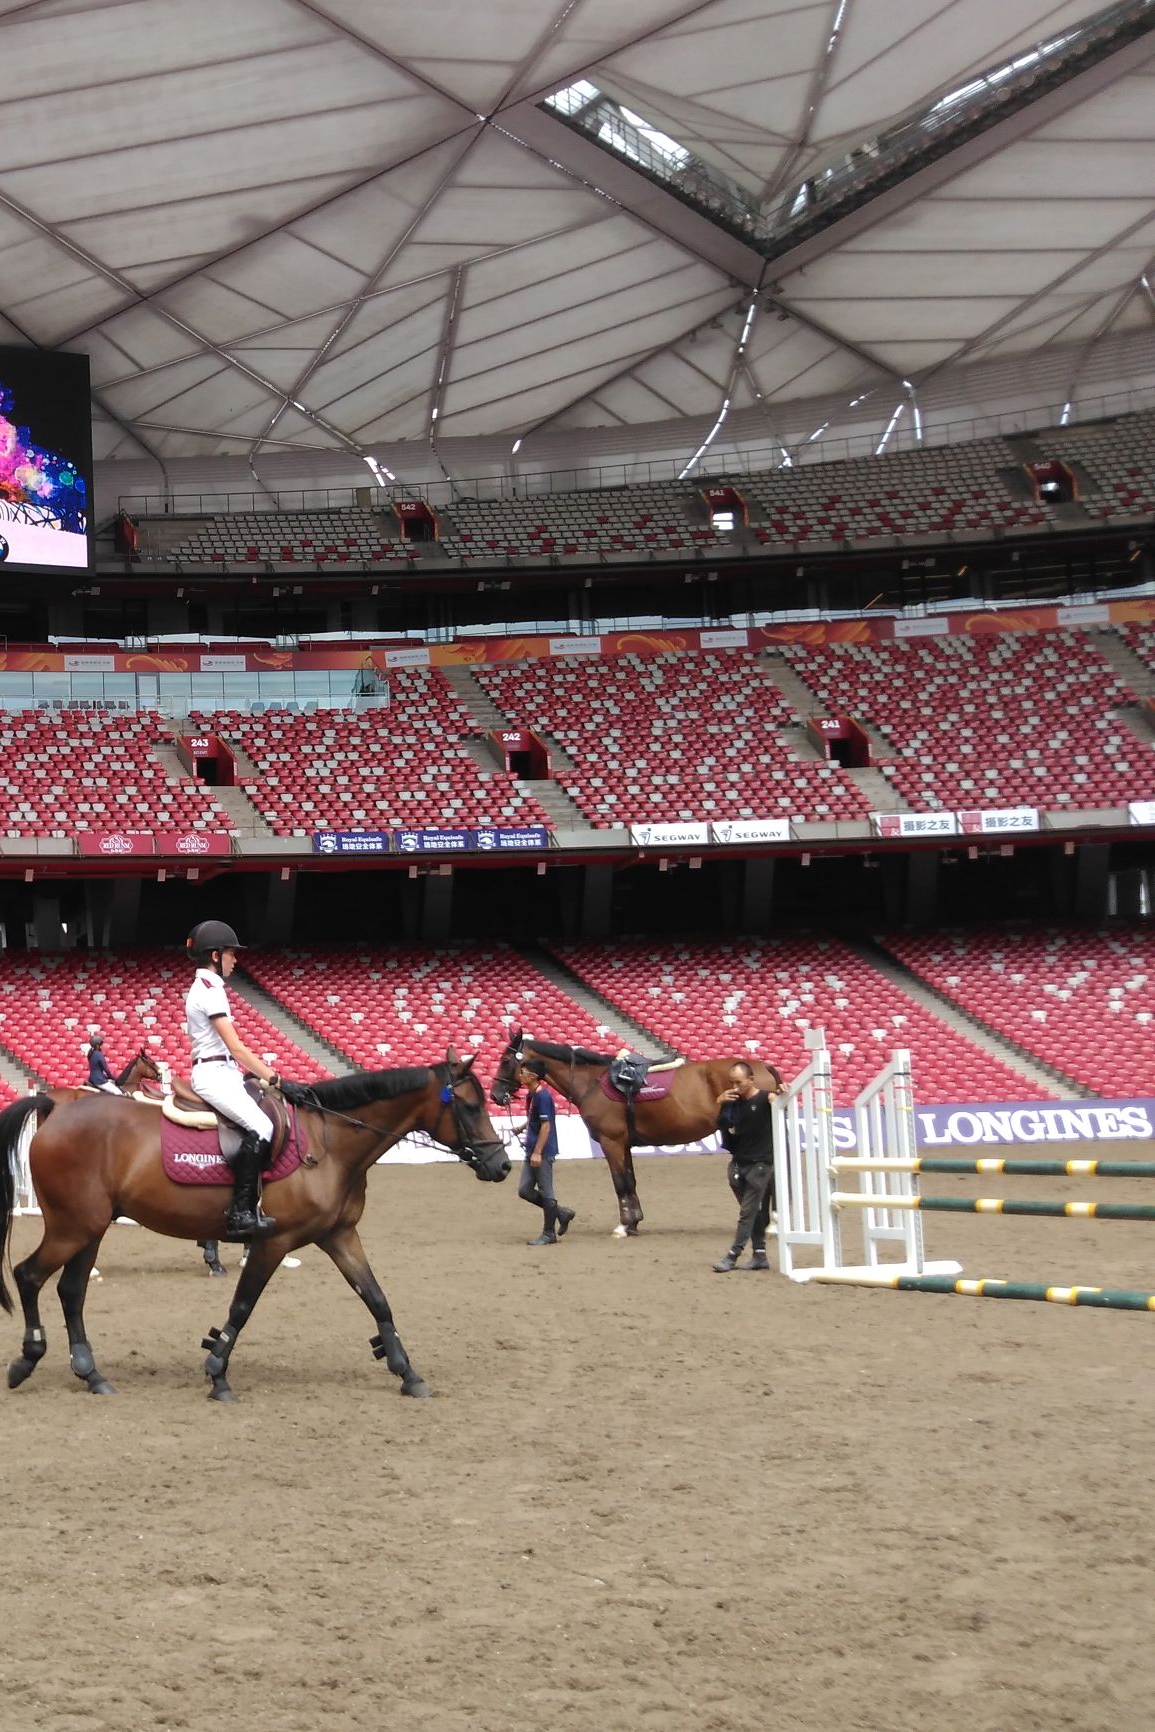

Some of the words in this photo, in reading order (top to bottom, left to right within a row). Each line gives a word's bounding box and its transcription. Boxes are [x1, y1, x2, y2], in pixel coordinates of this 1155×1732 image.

[821, 720, 840, 729] 241
[502, 732, 521, 741] 242
[190, 738, 209, 747] 243
[904, 820, 950, 832] 摄影之友
[985, 816, 1033, 828] 摄影之友
[918, 1106, 1153, 1144] LONGINES
[174, 1153, 225, 1164] LONGINE
